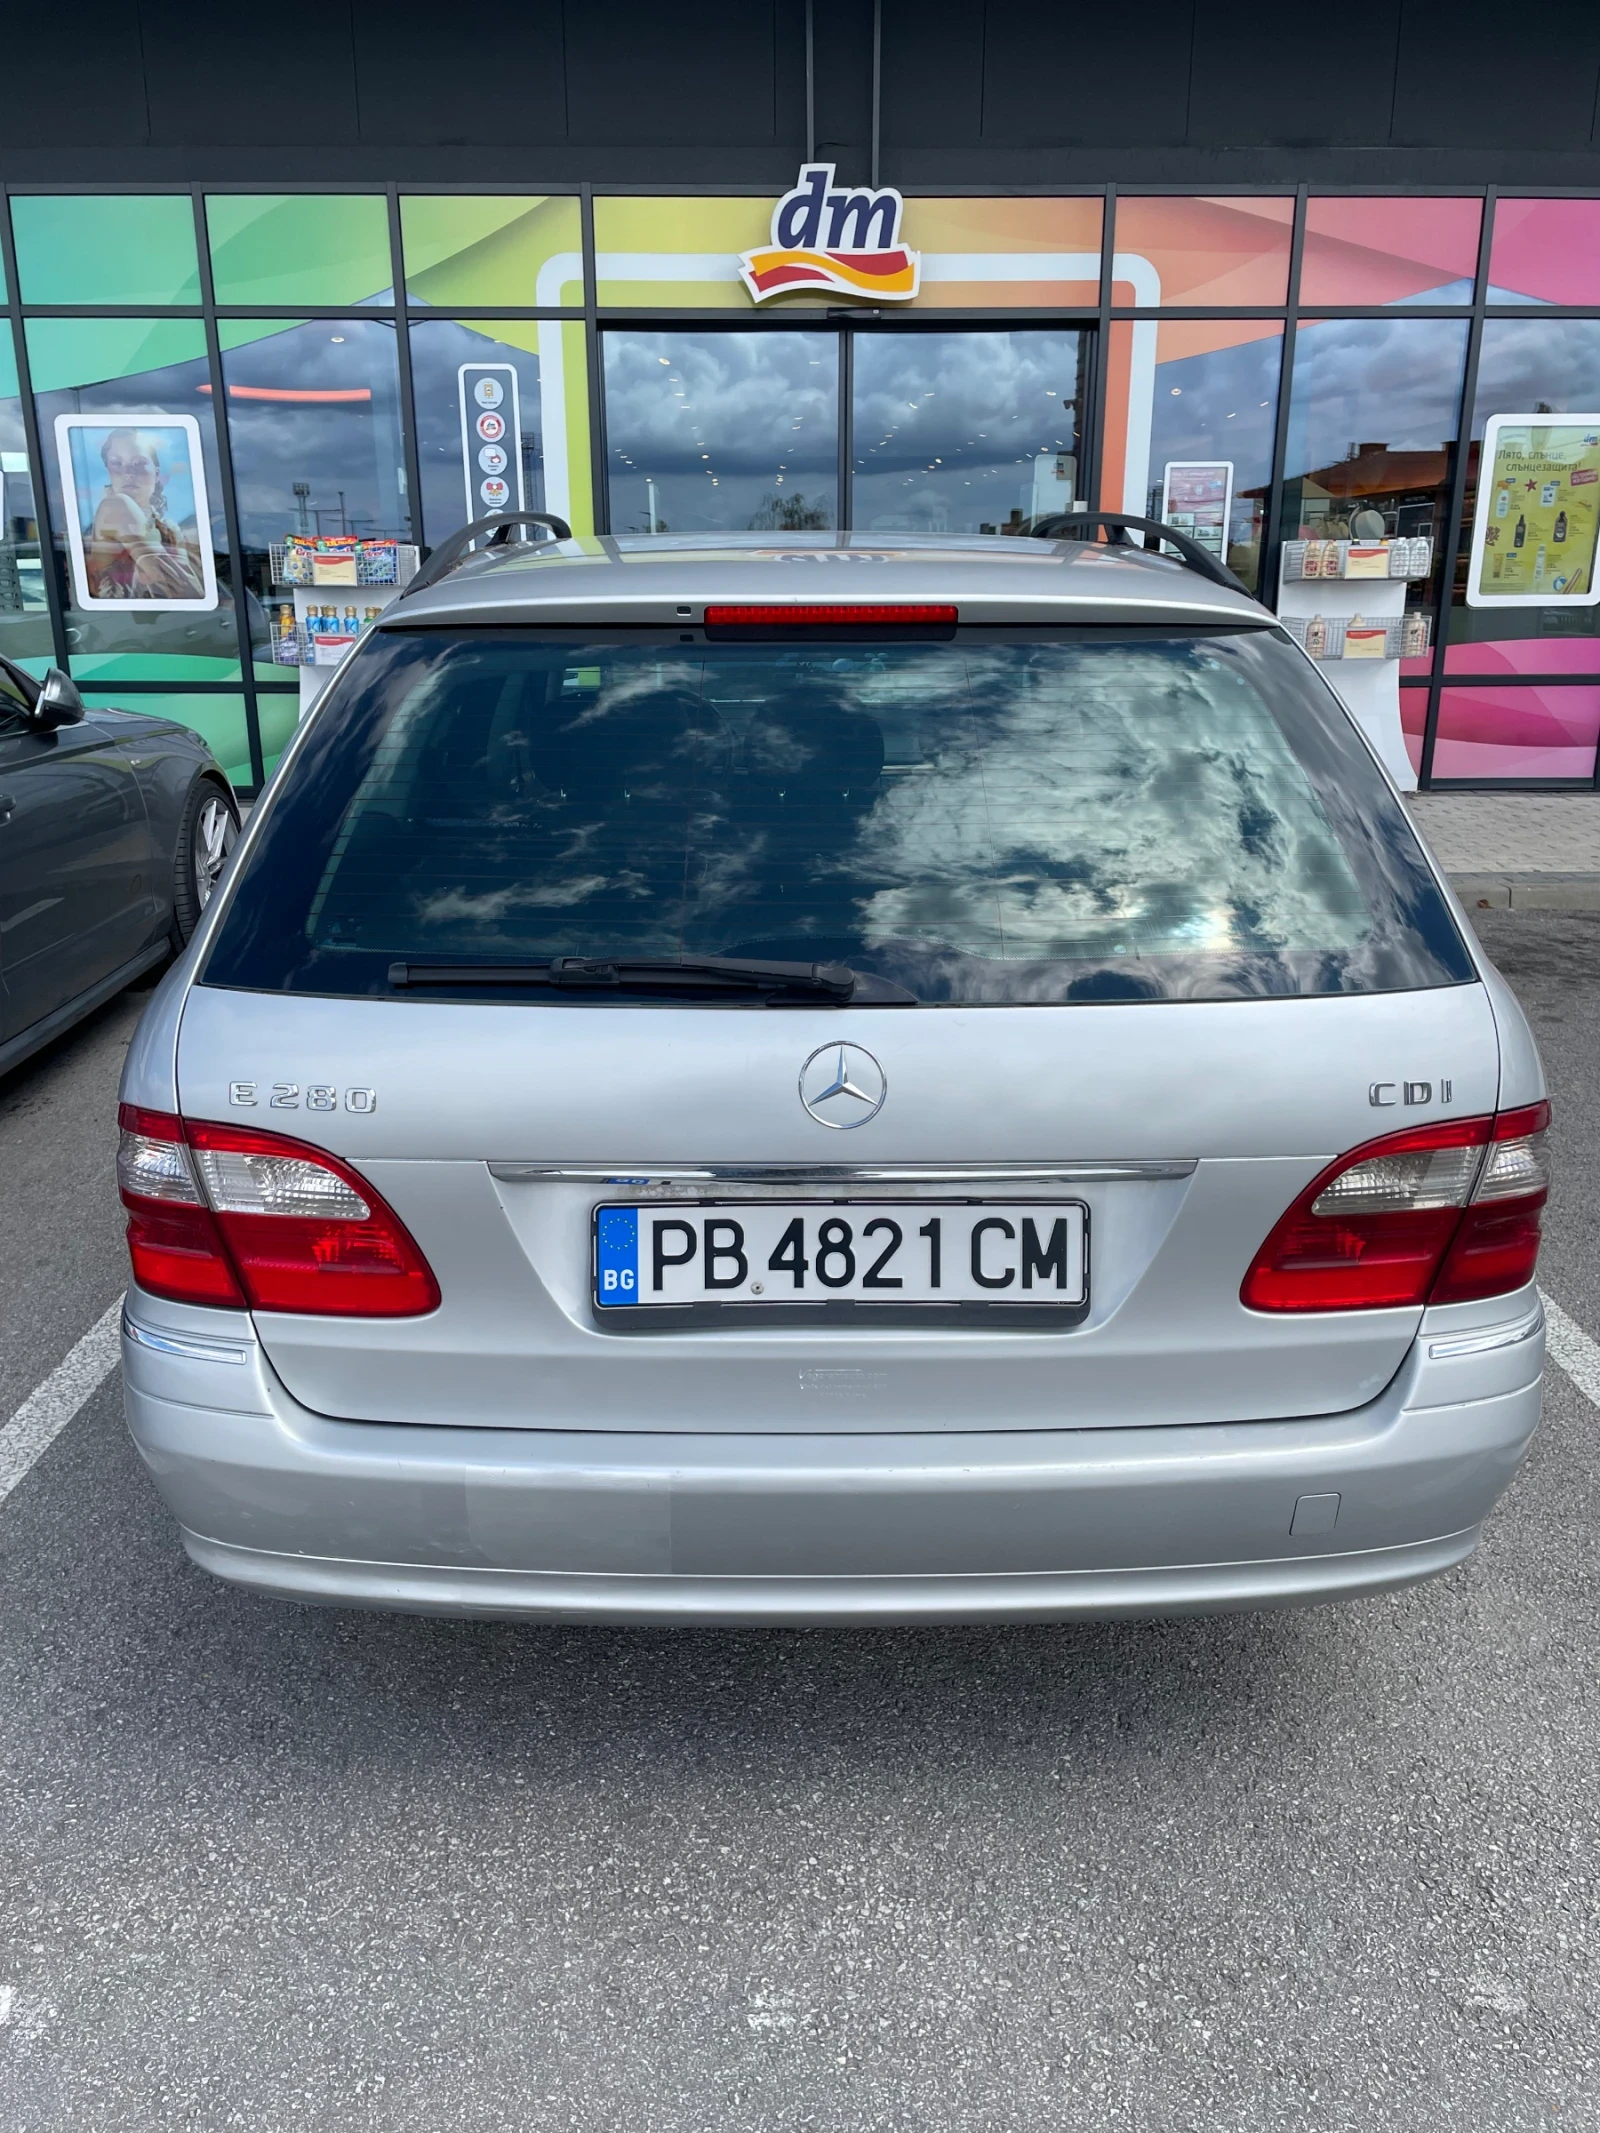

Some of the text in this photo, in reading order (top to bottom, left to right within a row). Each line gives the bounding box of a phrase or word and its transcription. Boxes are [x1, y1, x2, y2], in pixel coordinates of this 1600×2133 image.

[778, 171, 896, 249] dm
[1498, 450, 1567, 461] Лято, слънце,
[296, 547, 312, 559] Bre
[229, 1081, 377, 1113] E 280
[1369, 1079, 1452, 1107] CDI
[652, 1217, 1067, 1290] PB 4821 CM
[604, 1269, 634, 1290] BG
